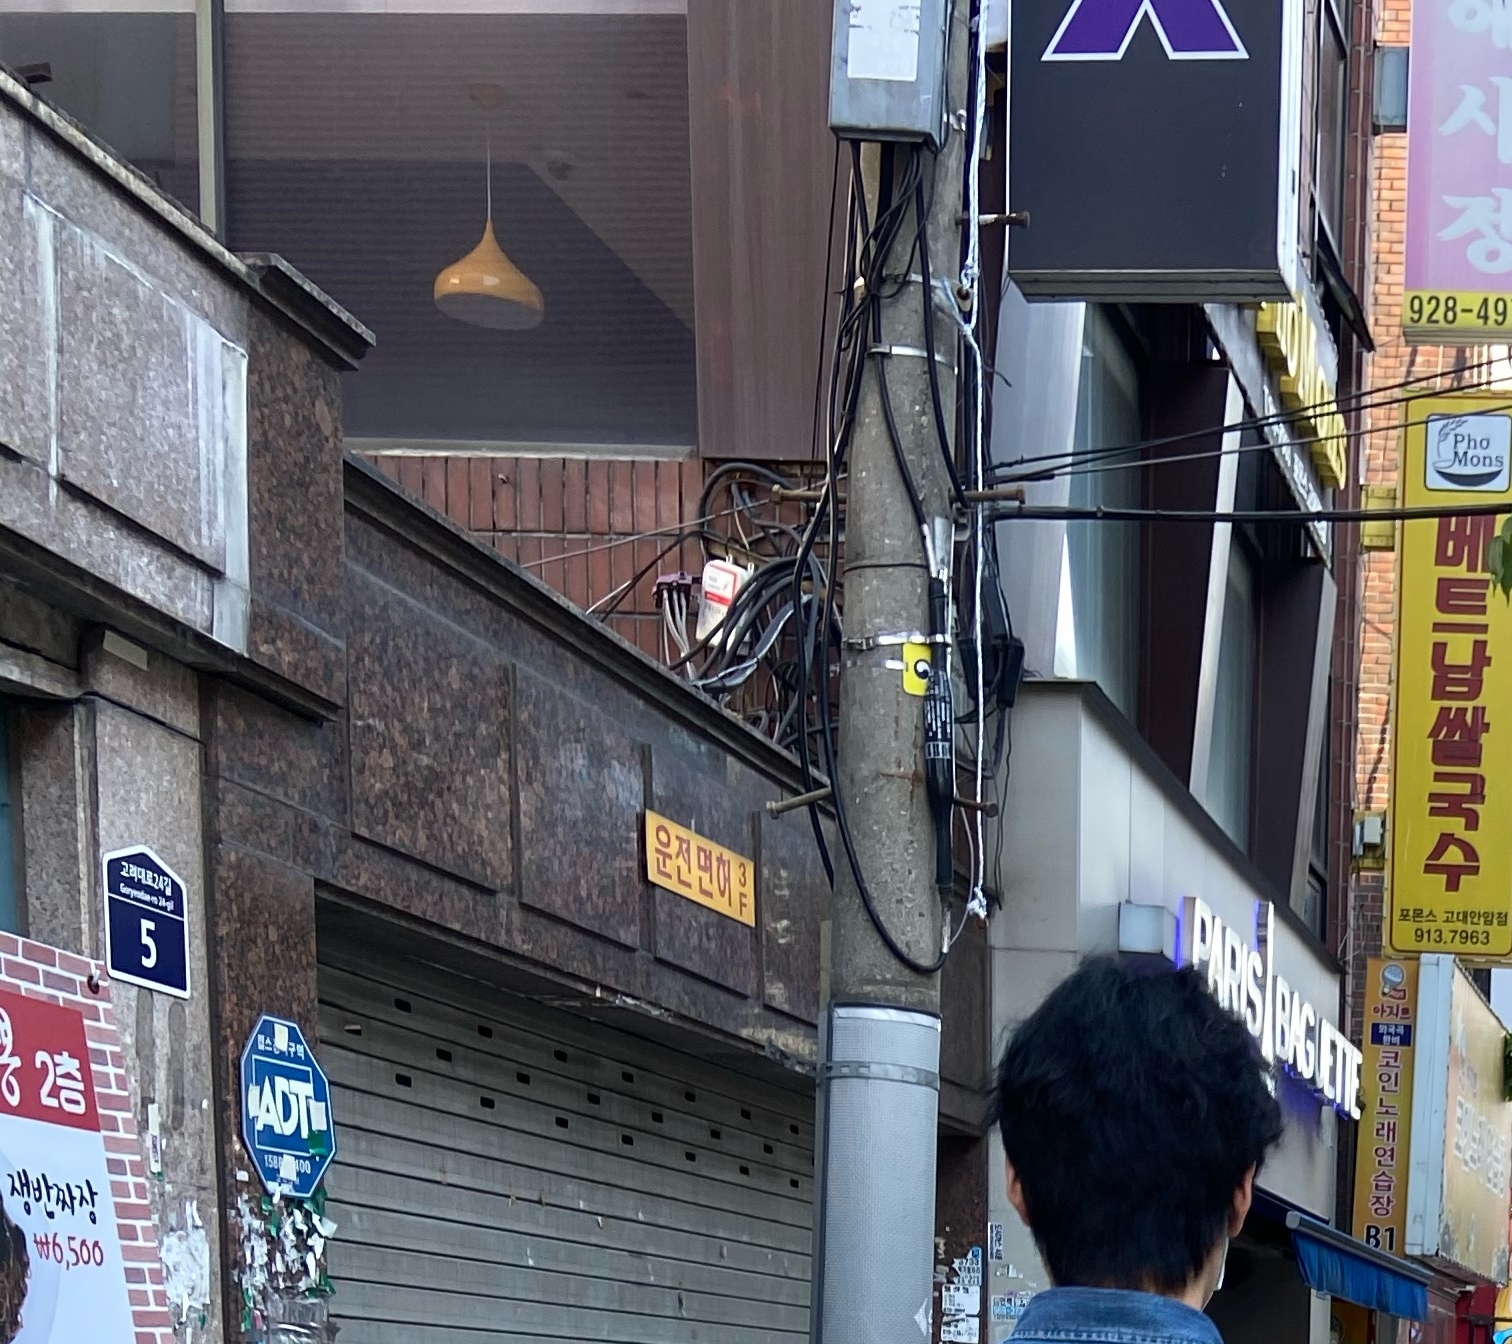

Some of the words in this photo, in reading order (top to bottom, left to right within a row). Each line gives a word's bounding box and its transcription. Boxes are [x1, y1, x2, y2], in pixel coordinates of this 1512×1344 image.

[1451, 451, 1504, 469] Mons
[1453, 432, 1491, 451] Pho
[1422, 515, 1494, 893] 베트남쌀국수
[654, 824, 733, 909] 운전면허
[141, 917, 157, 968] 5
[1398, 909, 1438, 925] 포몬스
[1441, 909, 1508, 928] 고대안암점
[1413, 927, 1491, 947] 913.7963
[1192, 896, 1263, 1038] PARIS
[1276, 974, 1363, 1121] BAGUETTE
[35, 1050, 87, 1115] 2층
[256, 1075, 314, 1140] ADT
[1370, 1049, 1403, 1217] 코인노래연습장
[7, 1168, 98, 1225] 쟁반짜장
[1364, 1223, 1396, 1252] B1
